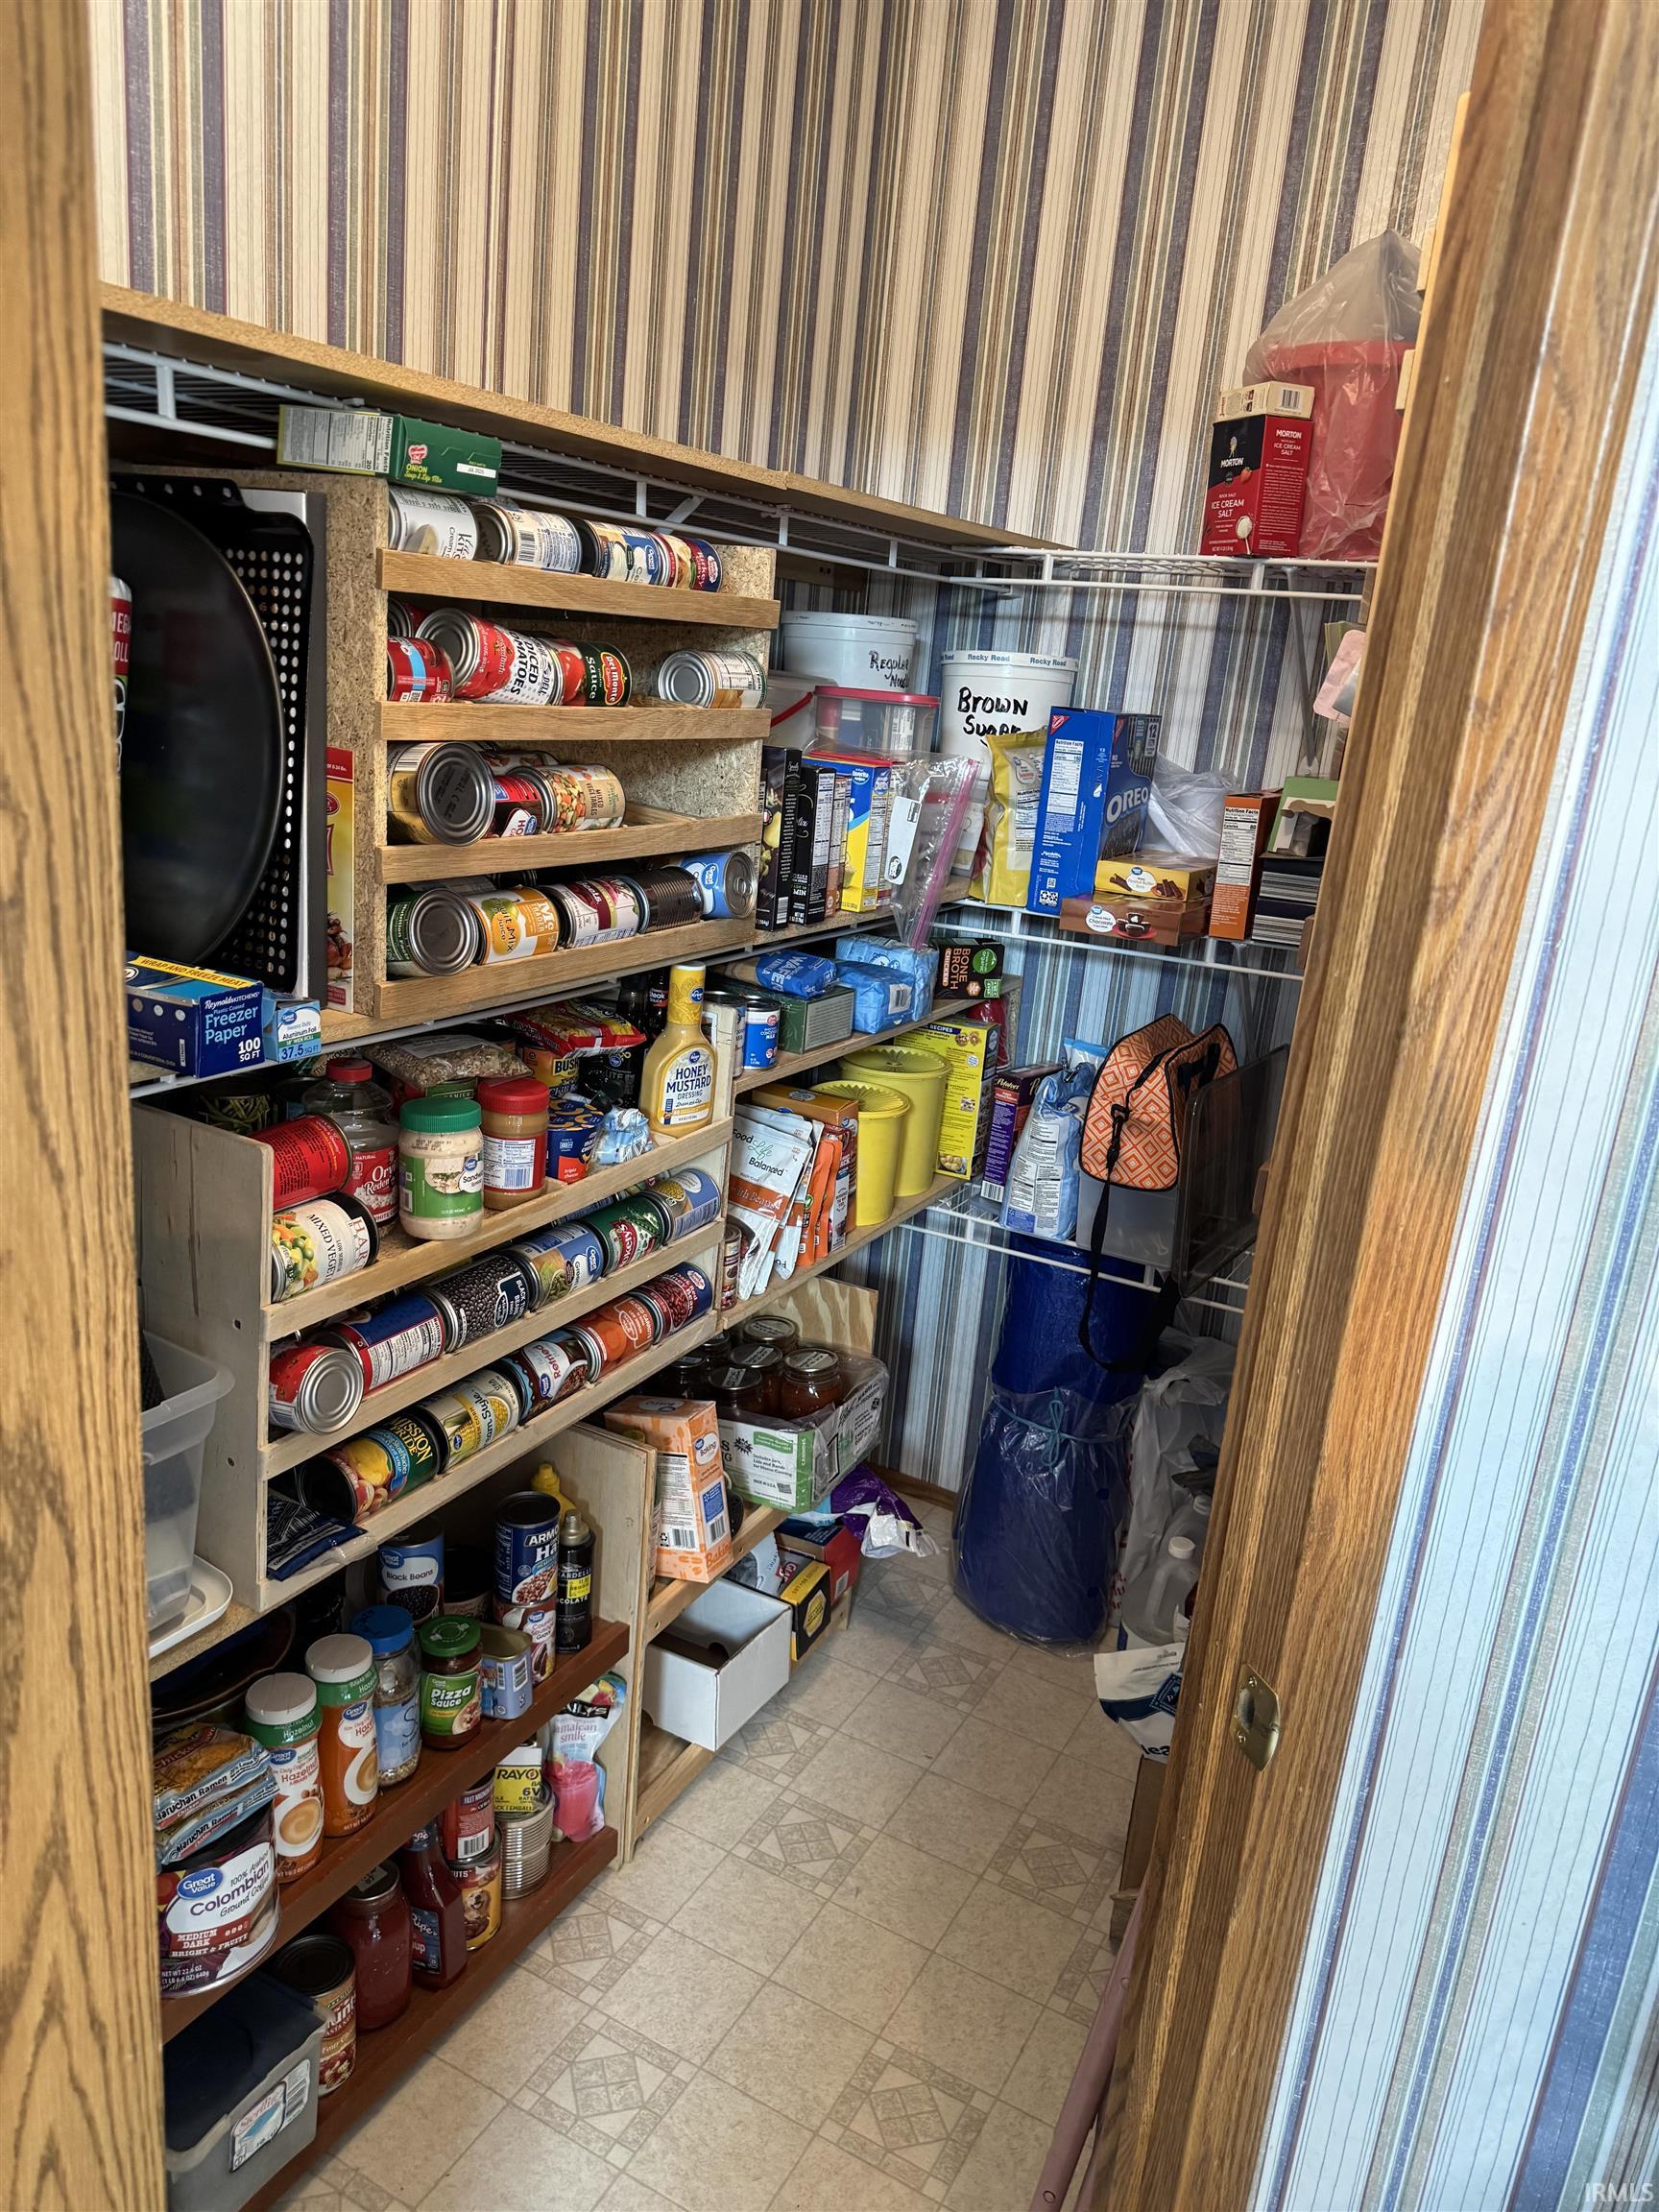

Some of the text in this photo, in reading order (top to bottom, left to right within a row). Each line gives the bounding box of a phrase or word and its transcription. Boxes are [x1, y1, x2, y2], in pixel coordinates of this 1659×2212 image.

[1276, 429, 1302, 440] MORTON
[1273, 443, 1301, 451] ICE CREAM
[1281, 448, 1293, 457] SALT
[406, 464, 428, 473] ONION
[1220, 457, 1244, 469] MORTON
[1220, 499, 1244, 508] CREAM
[1217, 509, 1233, 517] SALT
[523, 640, 539, 685] DICED
[967, 653, 1011, 662] Rocky Road
[1029, 657, 1067, 667] Rocky Road
[585, 657, 596, 700] Sauce
[595, 789, 604, 808] MIXED
[1107, 785, 1148, 824] OREO
[140, 958, 248, 988] WRAP AND FREEZE MEAT
[943, 950, 951, 986] CHICKEN
[950, 948, 962, 991] BROTH
[960, 948, 972, 983] BONE
[204, 997, 234, 1011] Reynolds
[204, 1006, 258, 1030] Freezer
[204, 1023, 248, 1046] Paper
[282, 1029, 308, 1040] Aluminum
[929, 1023, 953, 1034] RECIPES
[238, 1037, 261, 1054] 100
[281, 1044, 303, 1061] 37.5
[304, 1046, 313, 1055] SQ
[239, 1053, 250, 1063] SQ
[675, 1063, 709, 1080] HONEY
[666, 1075, 711, 1094] MUSTARD
[677, 1090, 703, 1100] DRESSING
[749, 1158, 784, 1177] Balanced
[307, 1214, 333, 1243] MIXED
[516, 1279, 526, 1301] BLACK
[642, 1312, 654, 1338] CARROTS
[534, 1344, 562, 1380] Refried
[390, 1425, 418, 1456] PRIDE
[754, 1453, 771, 1462] Includes
[774, 1467, 792, 1478] Canning
[387, 1568, 434, 1581] Black Beans
[430, 1684, 472, 1700] Pizza
[430, 1697, 462, 1708] Sauce
[560, 1731, 586, 1743] smile
[198, 1774, 228, 1796] Ramen
[177, 1824, 209, 1853] Maruchan
[182, 1872, 216, 1890] Great
[191, 1881, 217, 1893] Value
[230, 1871, 249, 1887] 100%
[190, 1860, 270, 1916] Colombian
[220, 1892, 251, 1918] Ground
[177, 1929, 218, 1942] MEDIUM
[182, 1937, 211, 1949] DARK
[171, 1947, 209, 1958] BRIGHT
[217, 1932, 249, 1951] FRUITY
[161, 1968, 172, 1978] NET
[173, 1967, 181, 1977] WT
[195, 1964, 203, 1974] OZ
